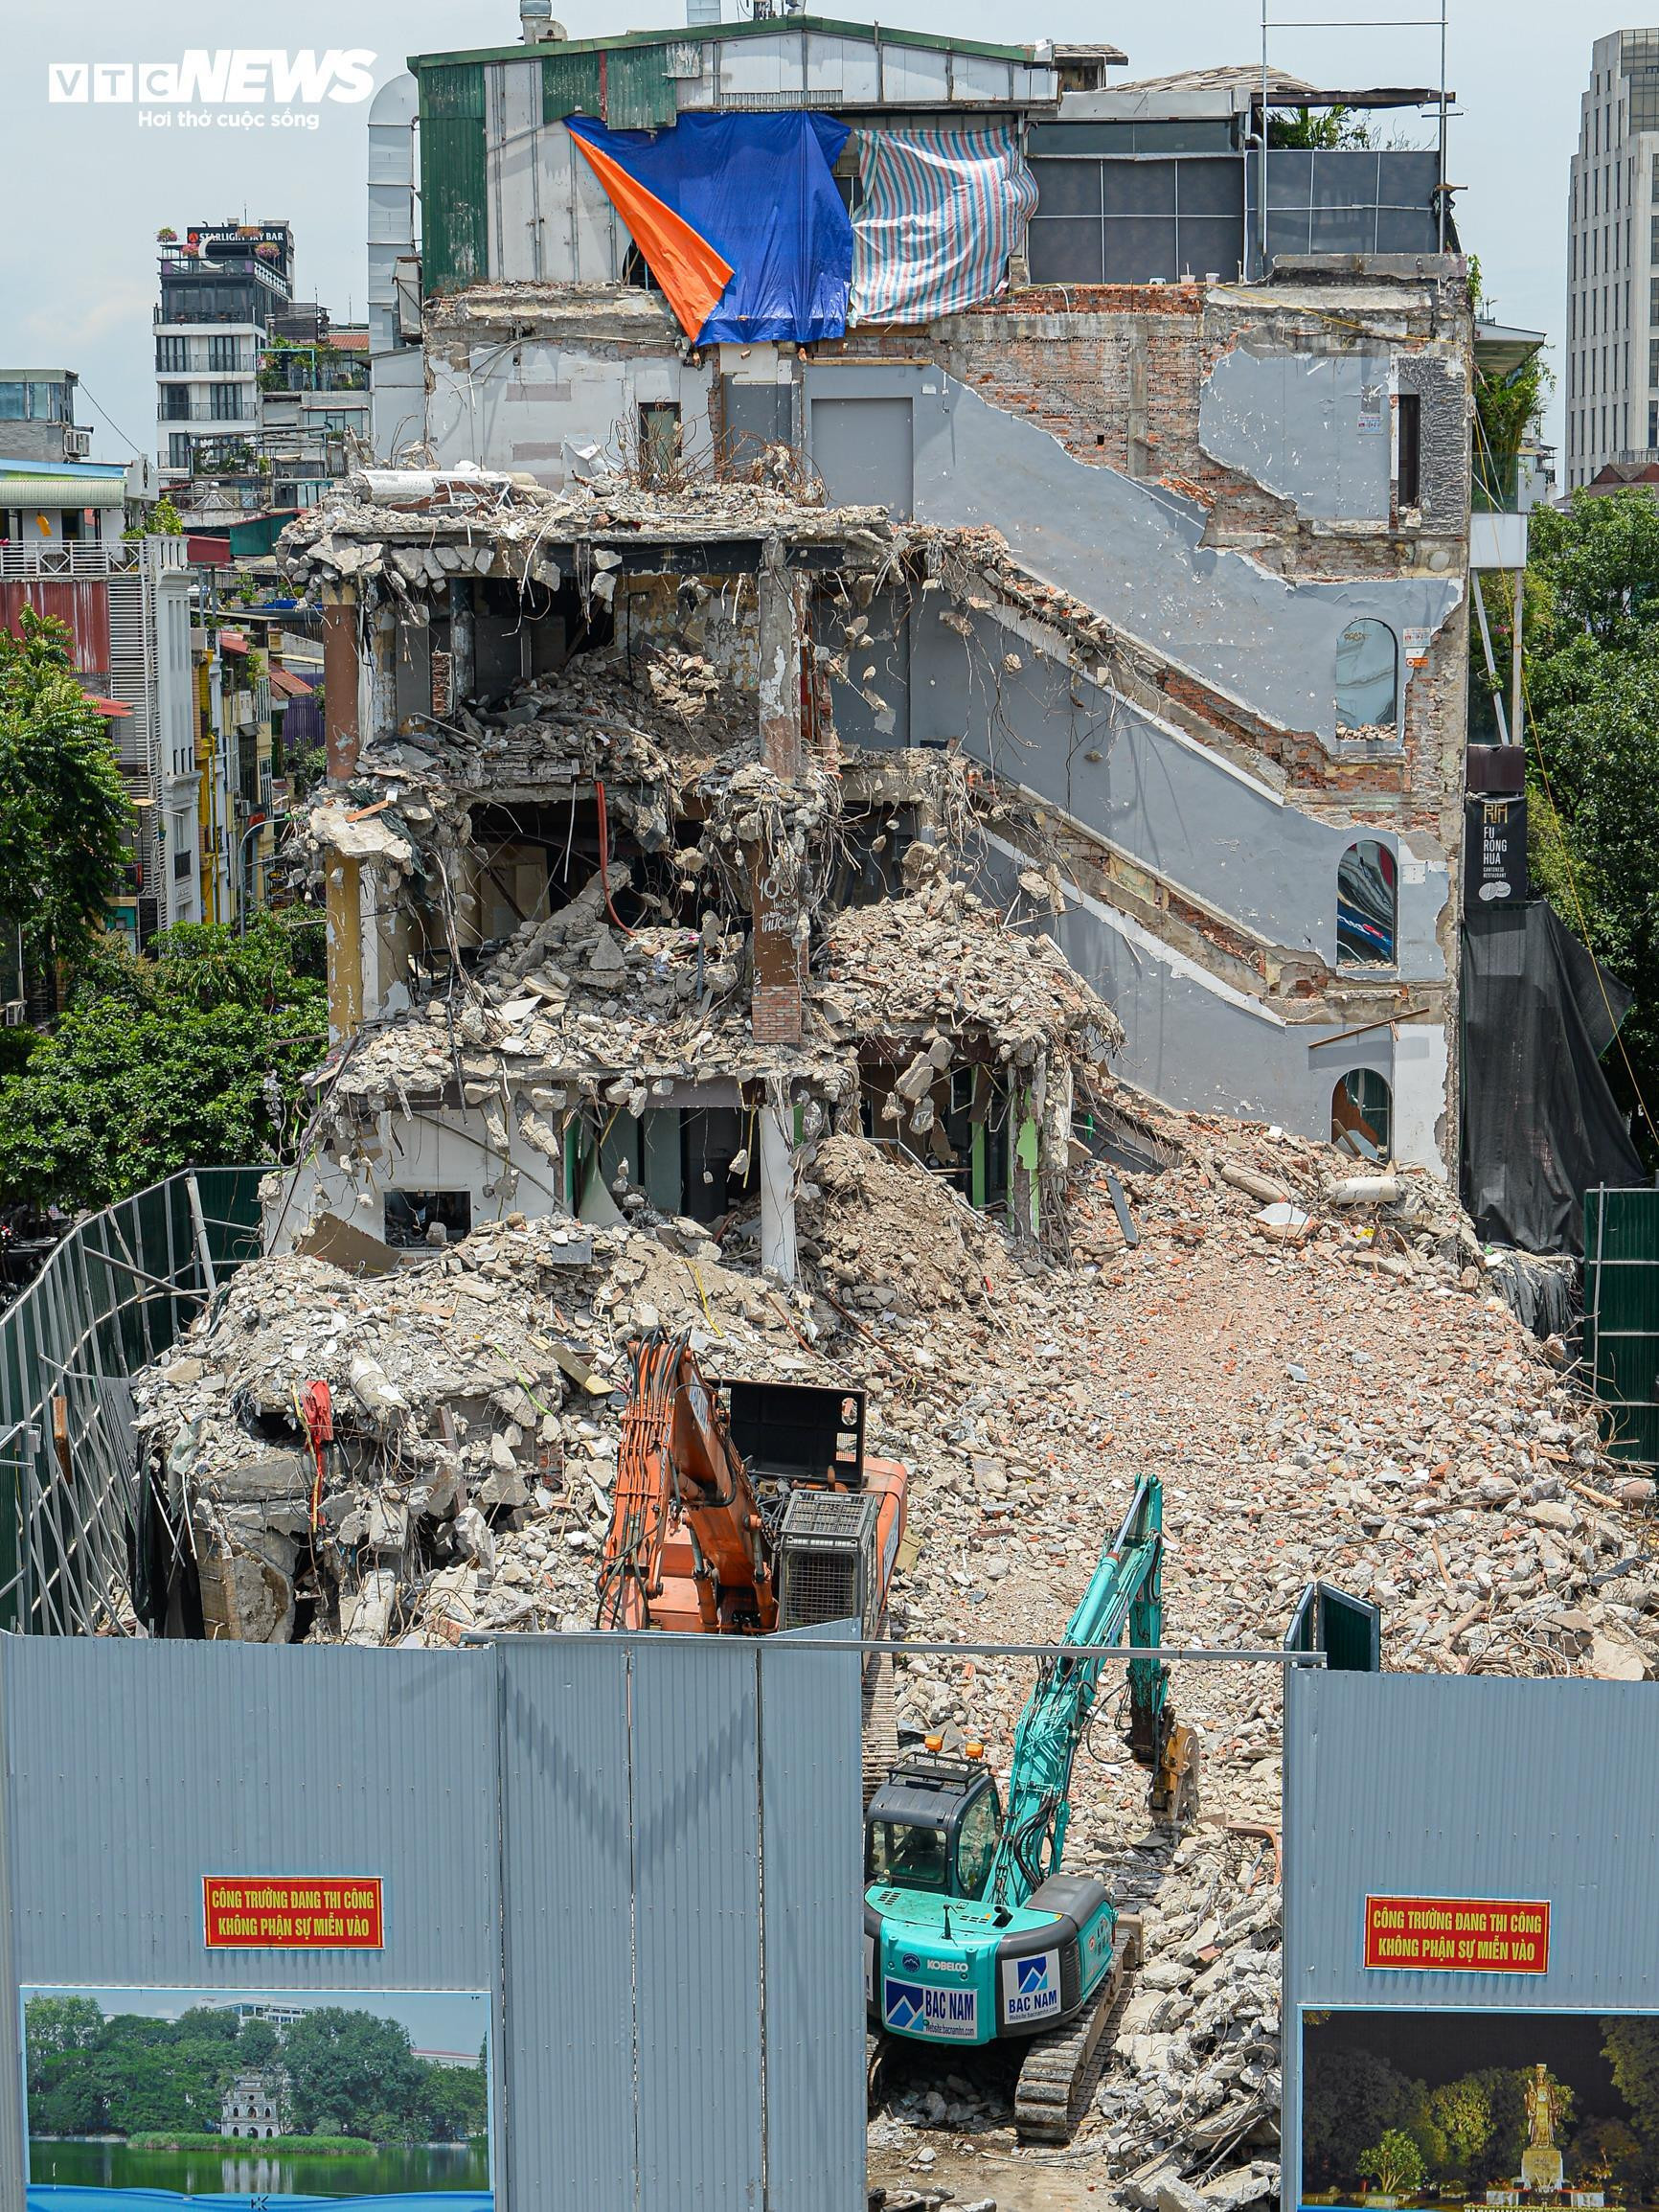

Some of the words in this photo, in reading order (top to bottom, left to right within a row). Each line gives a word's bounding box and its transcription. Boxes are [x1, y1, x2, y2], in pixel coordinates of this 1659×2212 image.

[265, 232, 284, 240] BAR
[1484, 826, 1495, 839] FU
[1483, 839, 1508, 852] RONG
[1483, 852, 1501, 865] HUA
[212, 1887, 242, 1908] CÔNG
[244, 1886, 288, 1909] TRƯỜNG
[290, 1890, 322, 1909] ĐANG
[324, 1891, 341, 1909] THI
[343, 1887, 375, 1909] CÔNG
[217, 1914, 258, 1936] KHÔNG
[261, 1914, 292, 1940] PHẬN
[295, 1916, 312, 1940] SỰ
[313, 1912, 344, 1936] MIỄN
[346, 1915, 370, 1936] VÀO
[1373, 1906, 1404, 1928] CÔNG
[1407, 1907, 1452, 1930] TRƯỜNG
[1455, 1912, 1487, 1932] ĐANG
[1489, 1913, 1508, 1932] THI
[1510, 1911, 1542, 1933] CÔNG
[1378, 1935, 1420, 1957] KHÔNG
[1421, 1936, 1455, 1962] PHẬN
[1458, 1938, 1476, 1963] SỰ
[1477, 1933, 1509, 1960] MIỄN
[1511, 1938, 1535, 1961] VÀO
[926, 1959, 968, 1973] KOBELCO
[925, 1990, 945, 2019] BAC
[949, 1993, 974, 2020] NAM
[1009, 1996, 1031, 2014] BAC
[1034, 1990, 1057, 2009] NAM
